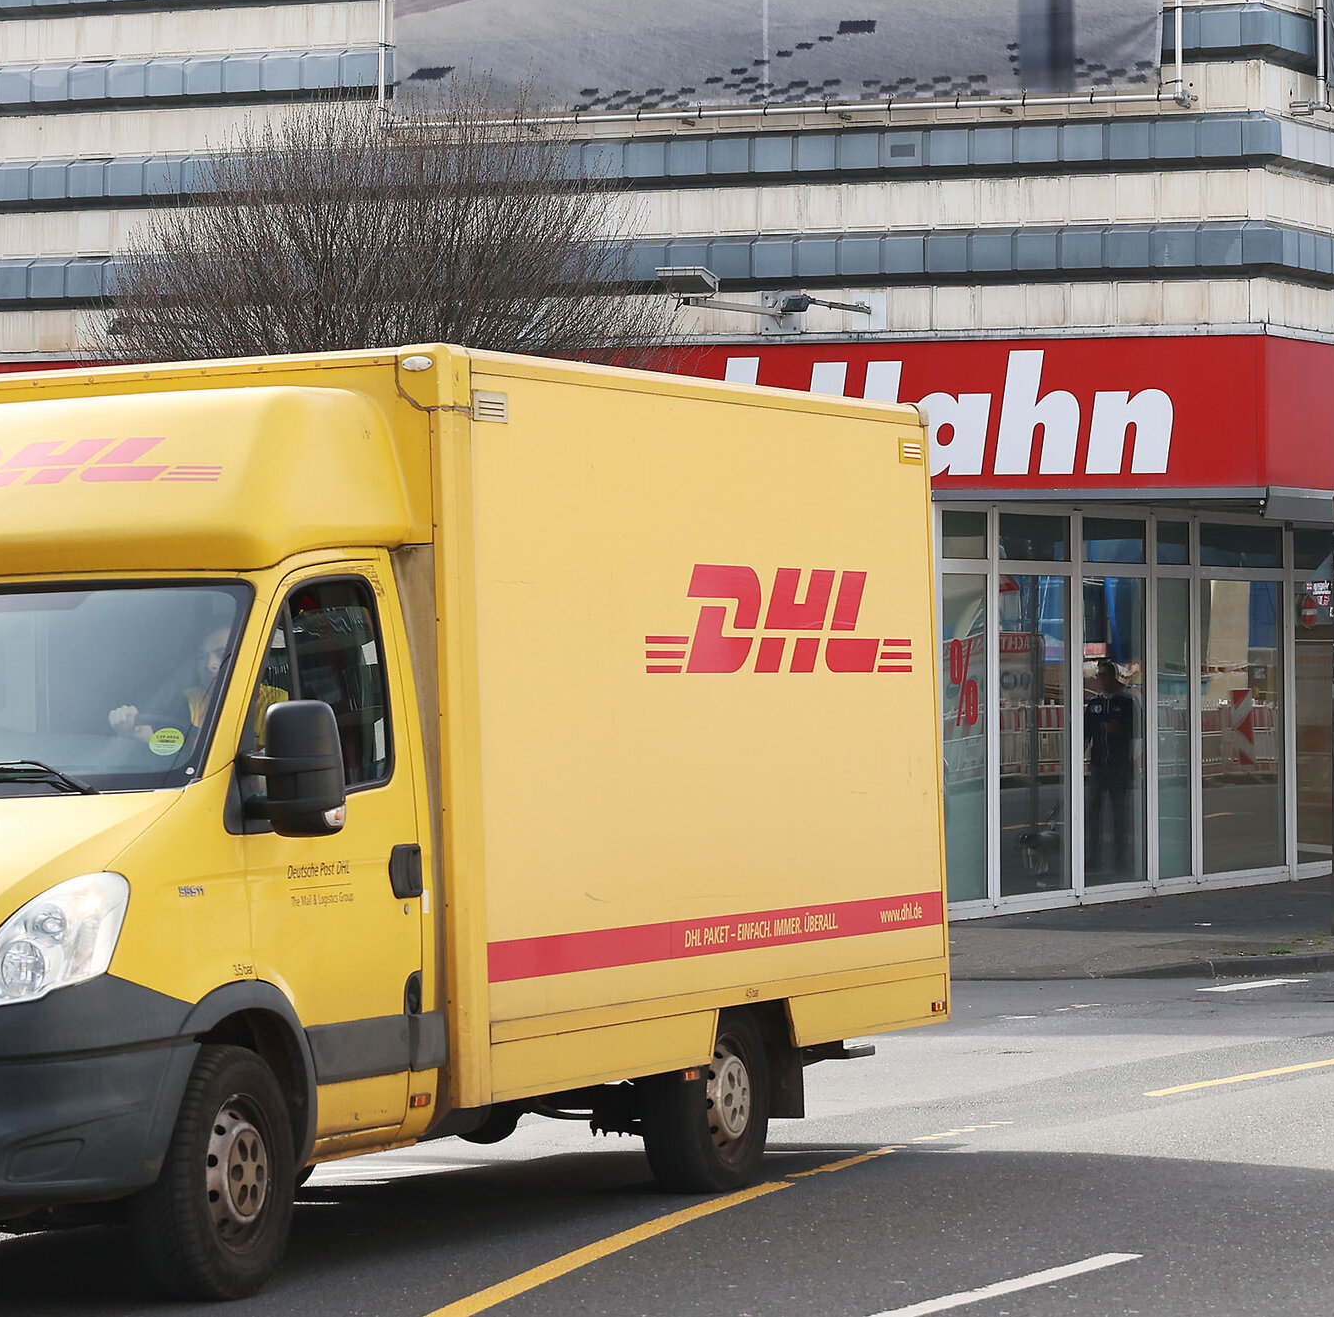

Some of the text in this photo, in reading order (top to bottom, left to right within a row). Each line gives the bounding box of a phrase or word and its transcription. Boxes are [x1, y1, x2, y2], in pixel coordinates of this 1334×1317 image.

[685, 563, 879, 674] DHL
[287, 859, 351, 879] Deutsche Post DHL
[291, 895, 301, 907] The
[301, 894, 312, 907] Mail
[318, 892, 339, 907] Logistics
[339, 891, 354, 906] Group
[880, 902, 923, 923] www.dhl.de
[684, 929, 702, 948] DHL
[703, 925, 730, 946] PAKET
[737, 920, 773, 941] EINFACH.
[774, 916, 803, 937] IMMER.
[804, 912, 838, 933] ÜBERALL.
[243, 963, 254, 976] bar
